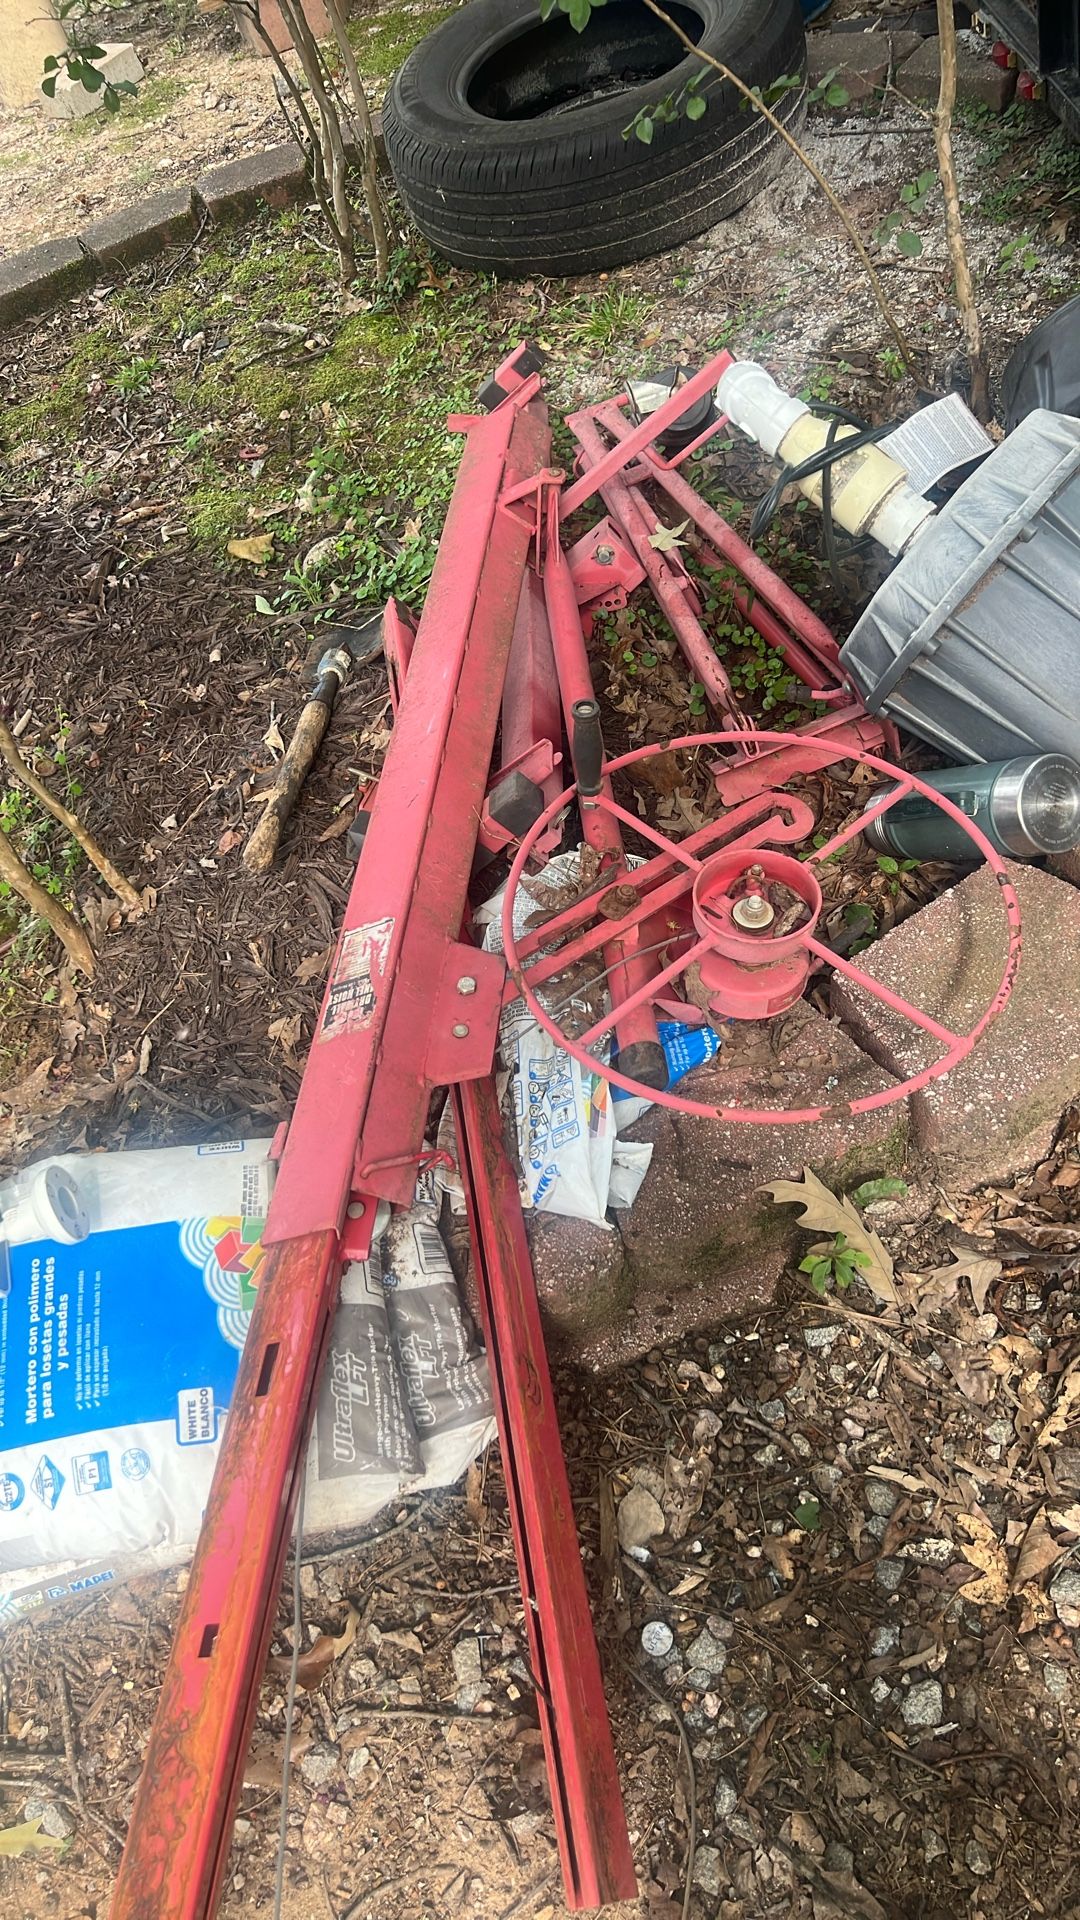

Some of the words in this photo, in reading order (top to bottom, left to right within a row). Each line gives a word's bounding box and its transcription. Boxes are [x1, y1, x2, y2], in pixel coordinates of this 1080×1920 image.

[43, 1257, 55, 1315] grandes
[56, 1294, 69, 1357] pesadas
[429, 1304, 441, 1331] Mortar
[450, 1307, 460, 1327] para
[29, 1327, 38, 1355] con
[40, 1320, 52, 1377] losetas
[411, 1334, 440, 1378] LFT
[57, 1362, 69, 1371] y
[346, 1352, 369, 1406] LFT
[398, 1336, 436, 1426] Ultraflex
[25, 1359, 37, 1424] Mortero
[43, 1381, 55, 1419] para
[330, 1350, 355, 1462] Ultraflex
[188, 1400, 197, 1440] WHITE
[200, 1389, 210, 1438] BLANCO
[4, 1480, 13, 1504] C2TE
[88, 1468, 96, 1479] P1
[69, 1570, 114, 1593] MAPEI
